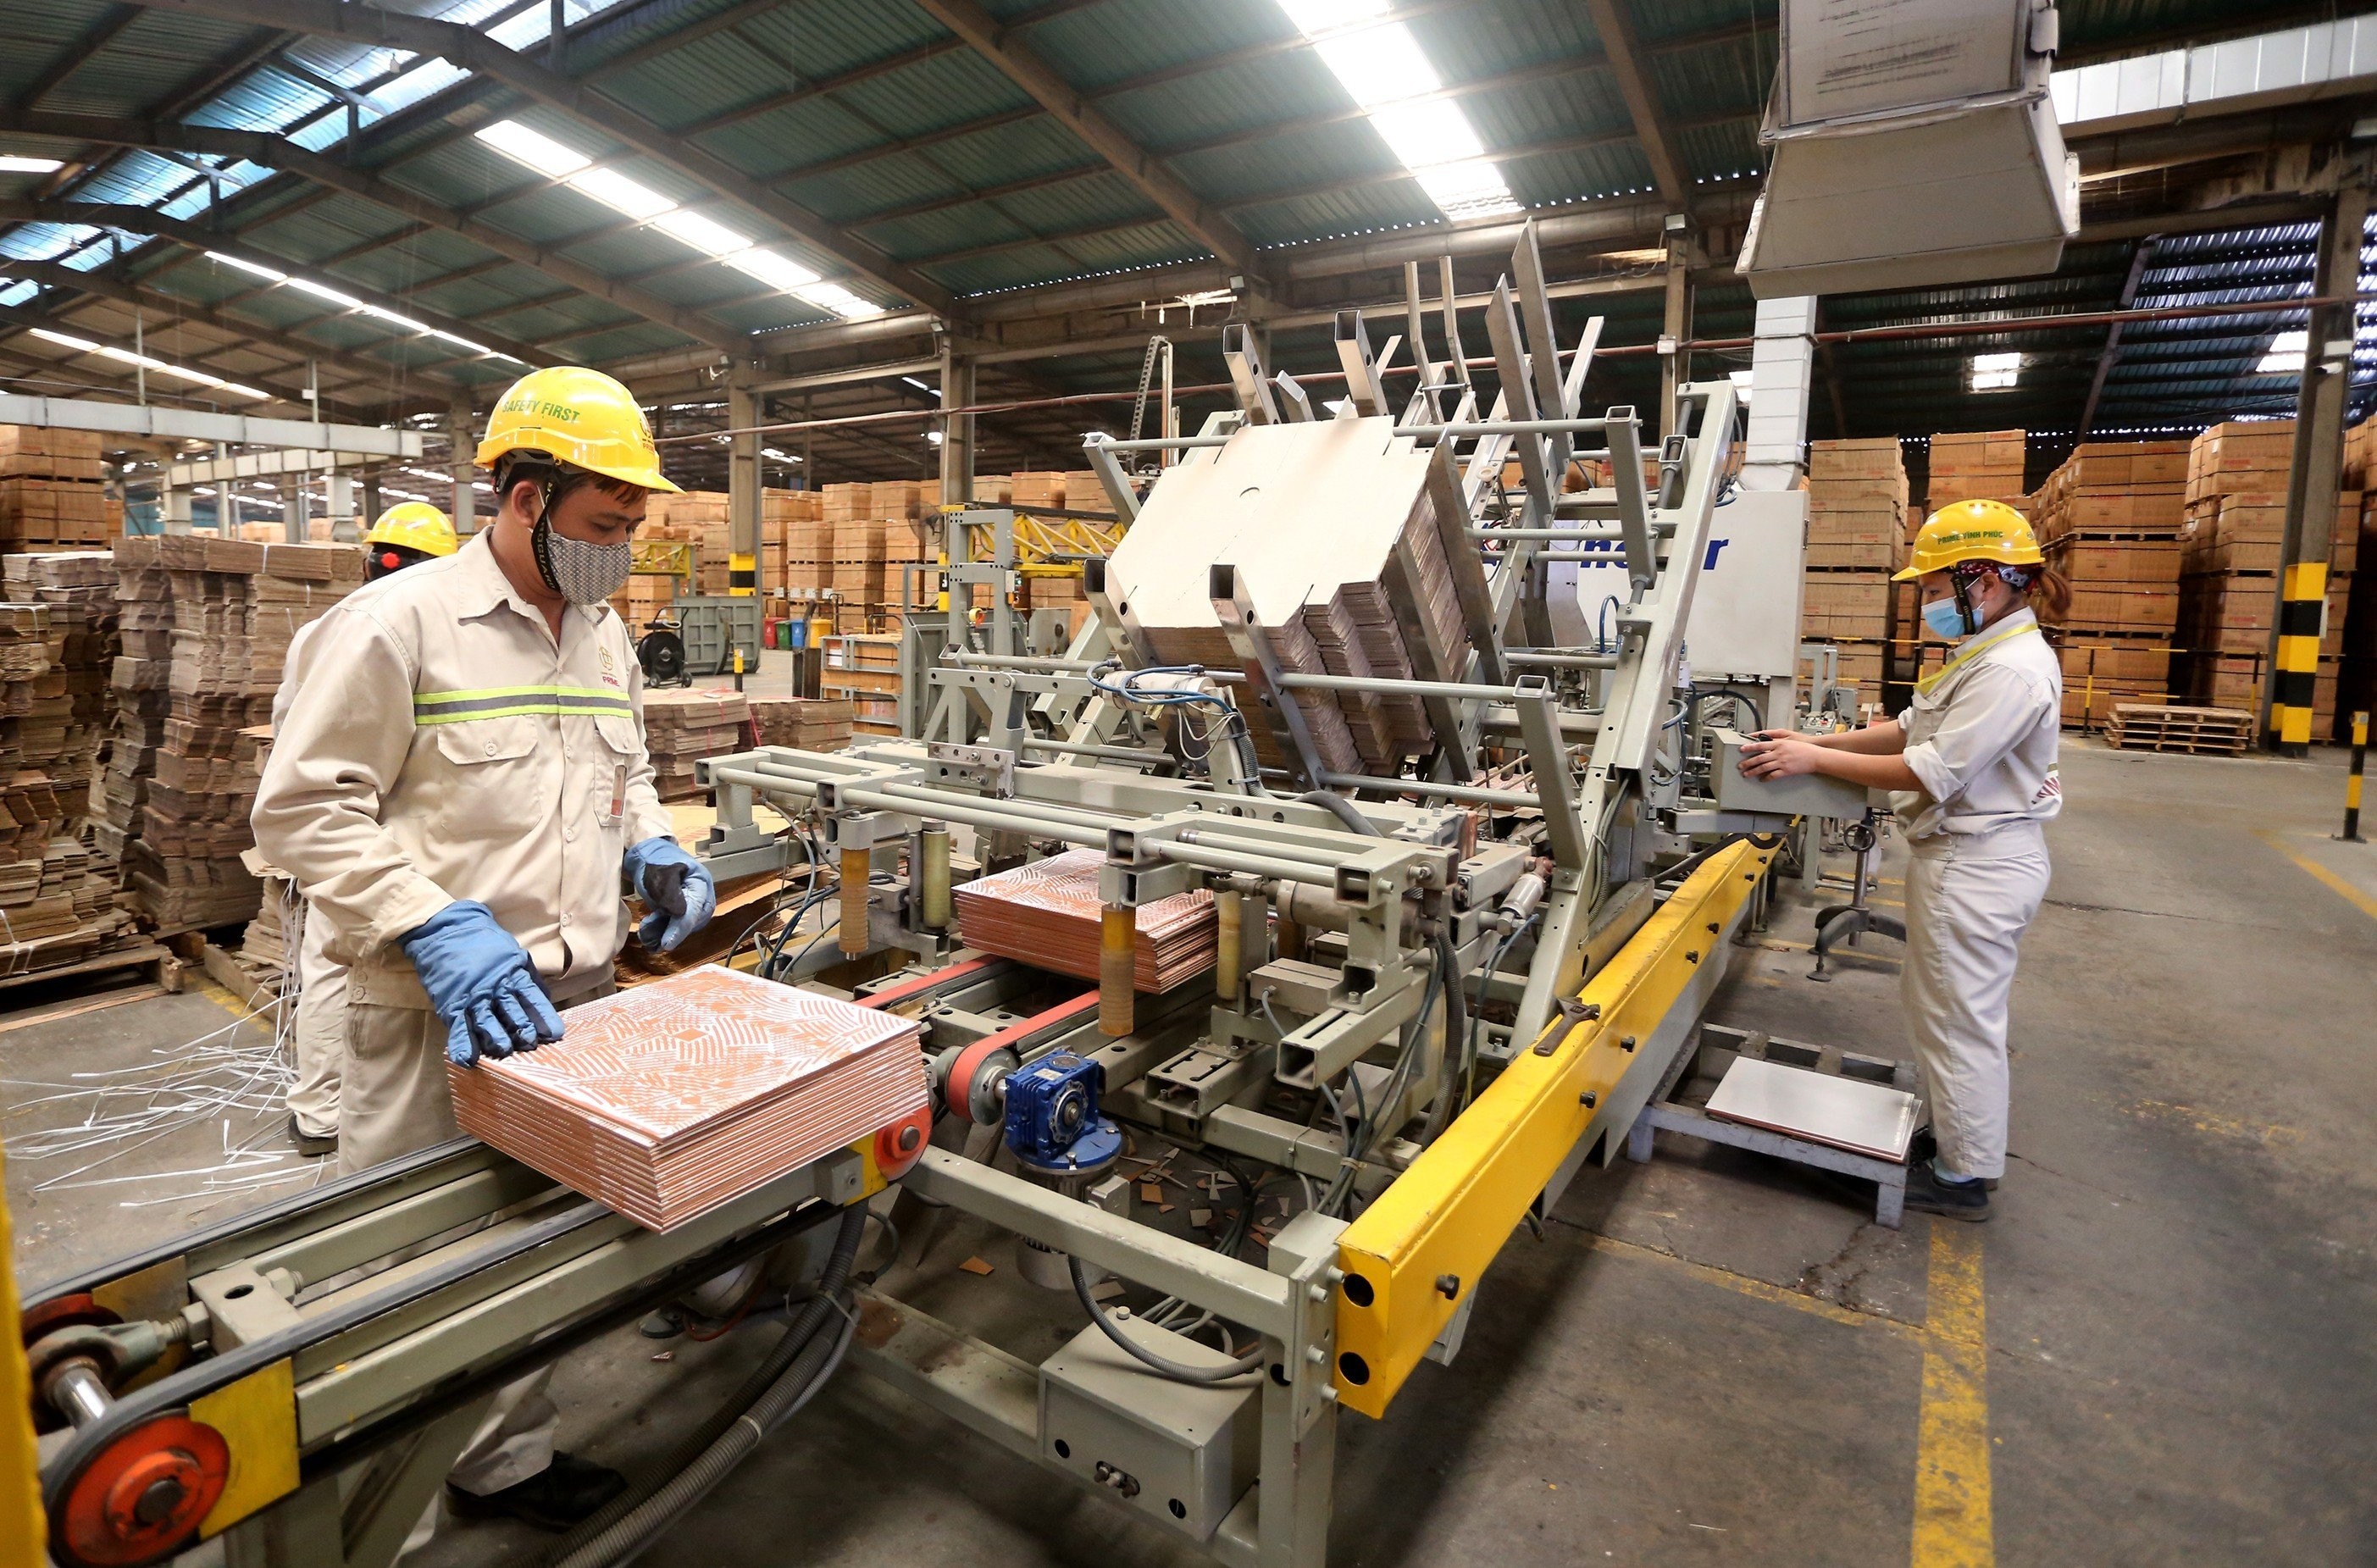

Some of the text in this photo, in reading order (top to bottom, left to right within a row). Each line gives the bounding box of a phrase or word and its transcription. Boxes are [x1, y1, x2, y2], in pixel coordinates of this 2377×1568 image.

[502, 400, 580, 424] SAFETY FIRST
[1937, 534, 1960, 545] PRIME
[1982, 529, 2003, 539] PHÚC
